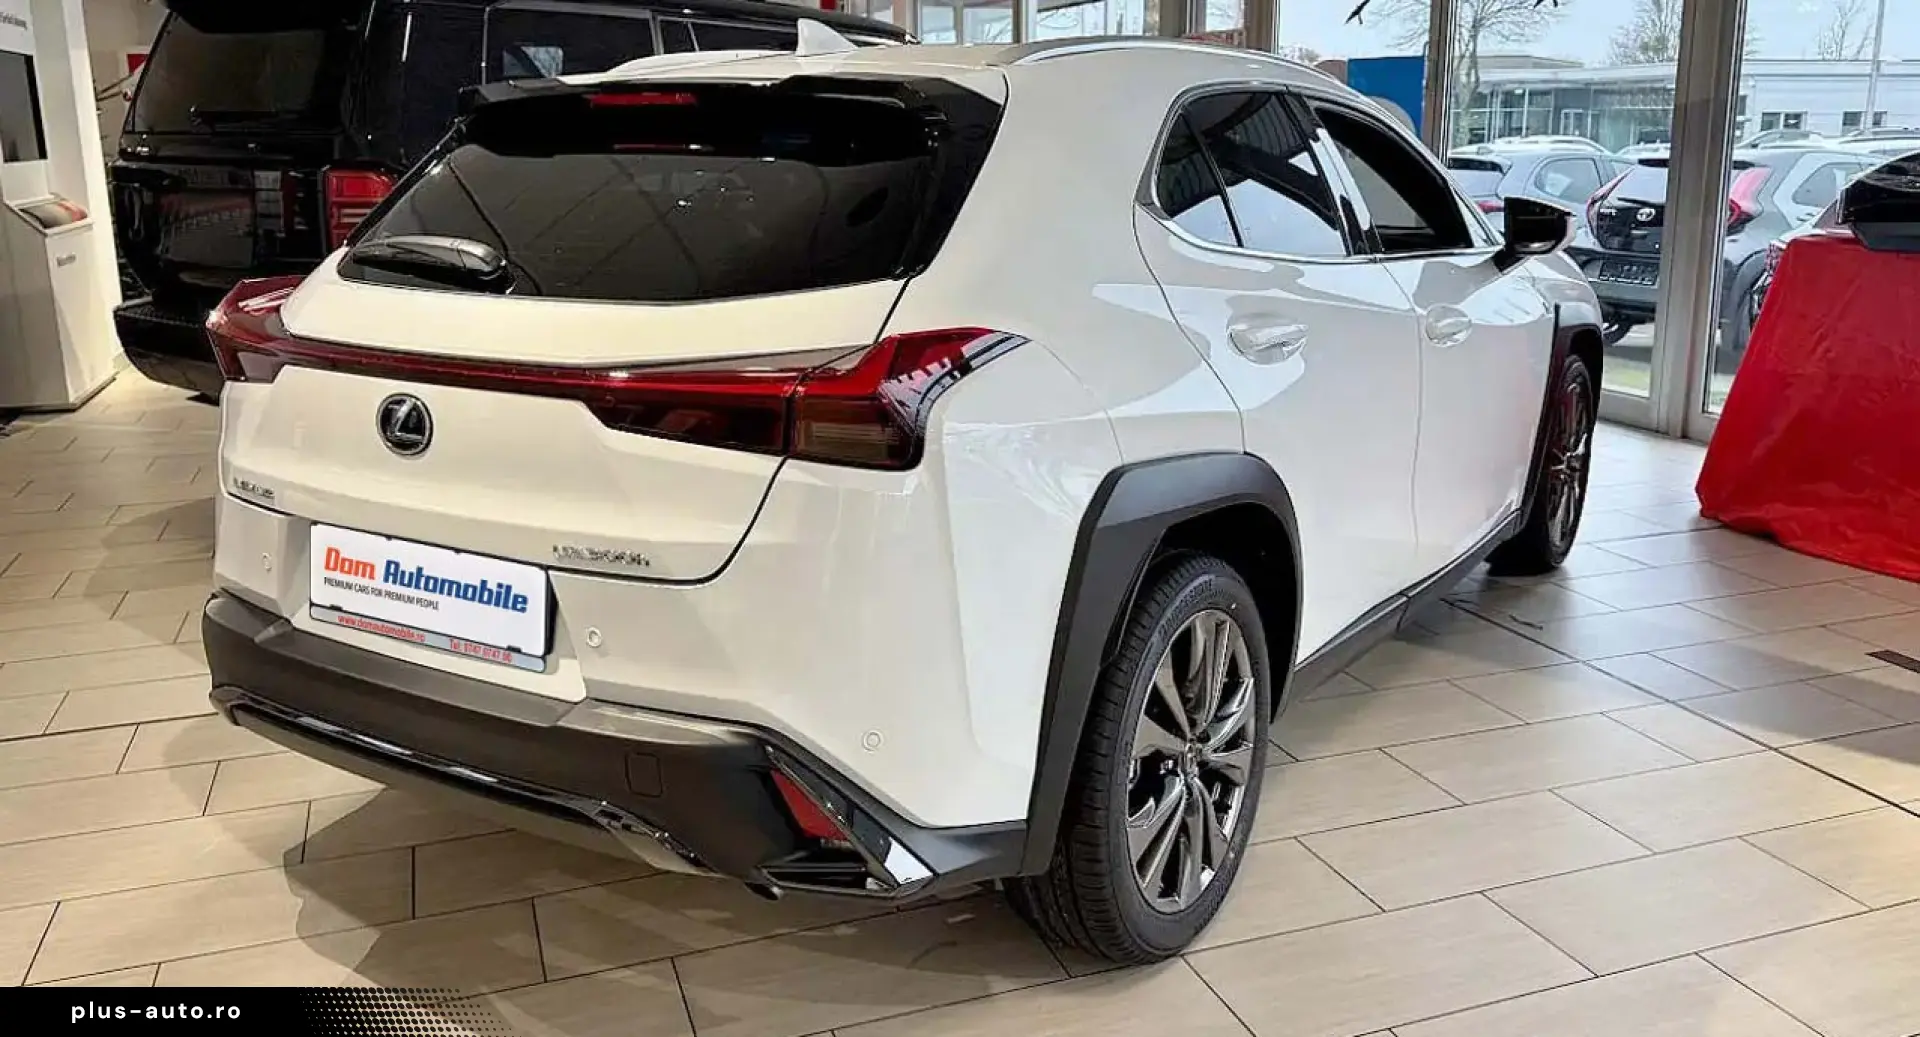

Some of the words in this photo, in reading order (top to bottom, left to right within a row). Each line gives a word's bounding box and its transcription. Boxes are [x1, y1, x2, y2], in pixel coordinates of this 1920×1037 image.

[323, 576, 353, 591] PREMIUM
[354, 582, 370, 595] CARS
[370, 586, 382, 598] FOR
[384, 589, 415, 605] PREMIUM
[415, 597, 440, 611] PEOPLE
[324, 546, 376, 581] Dom
[382, 559, 528, 613] Automobile
